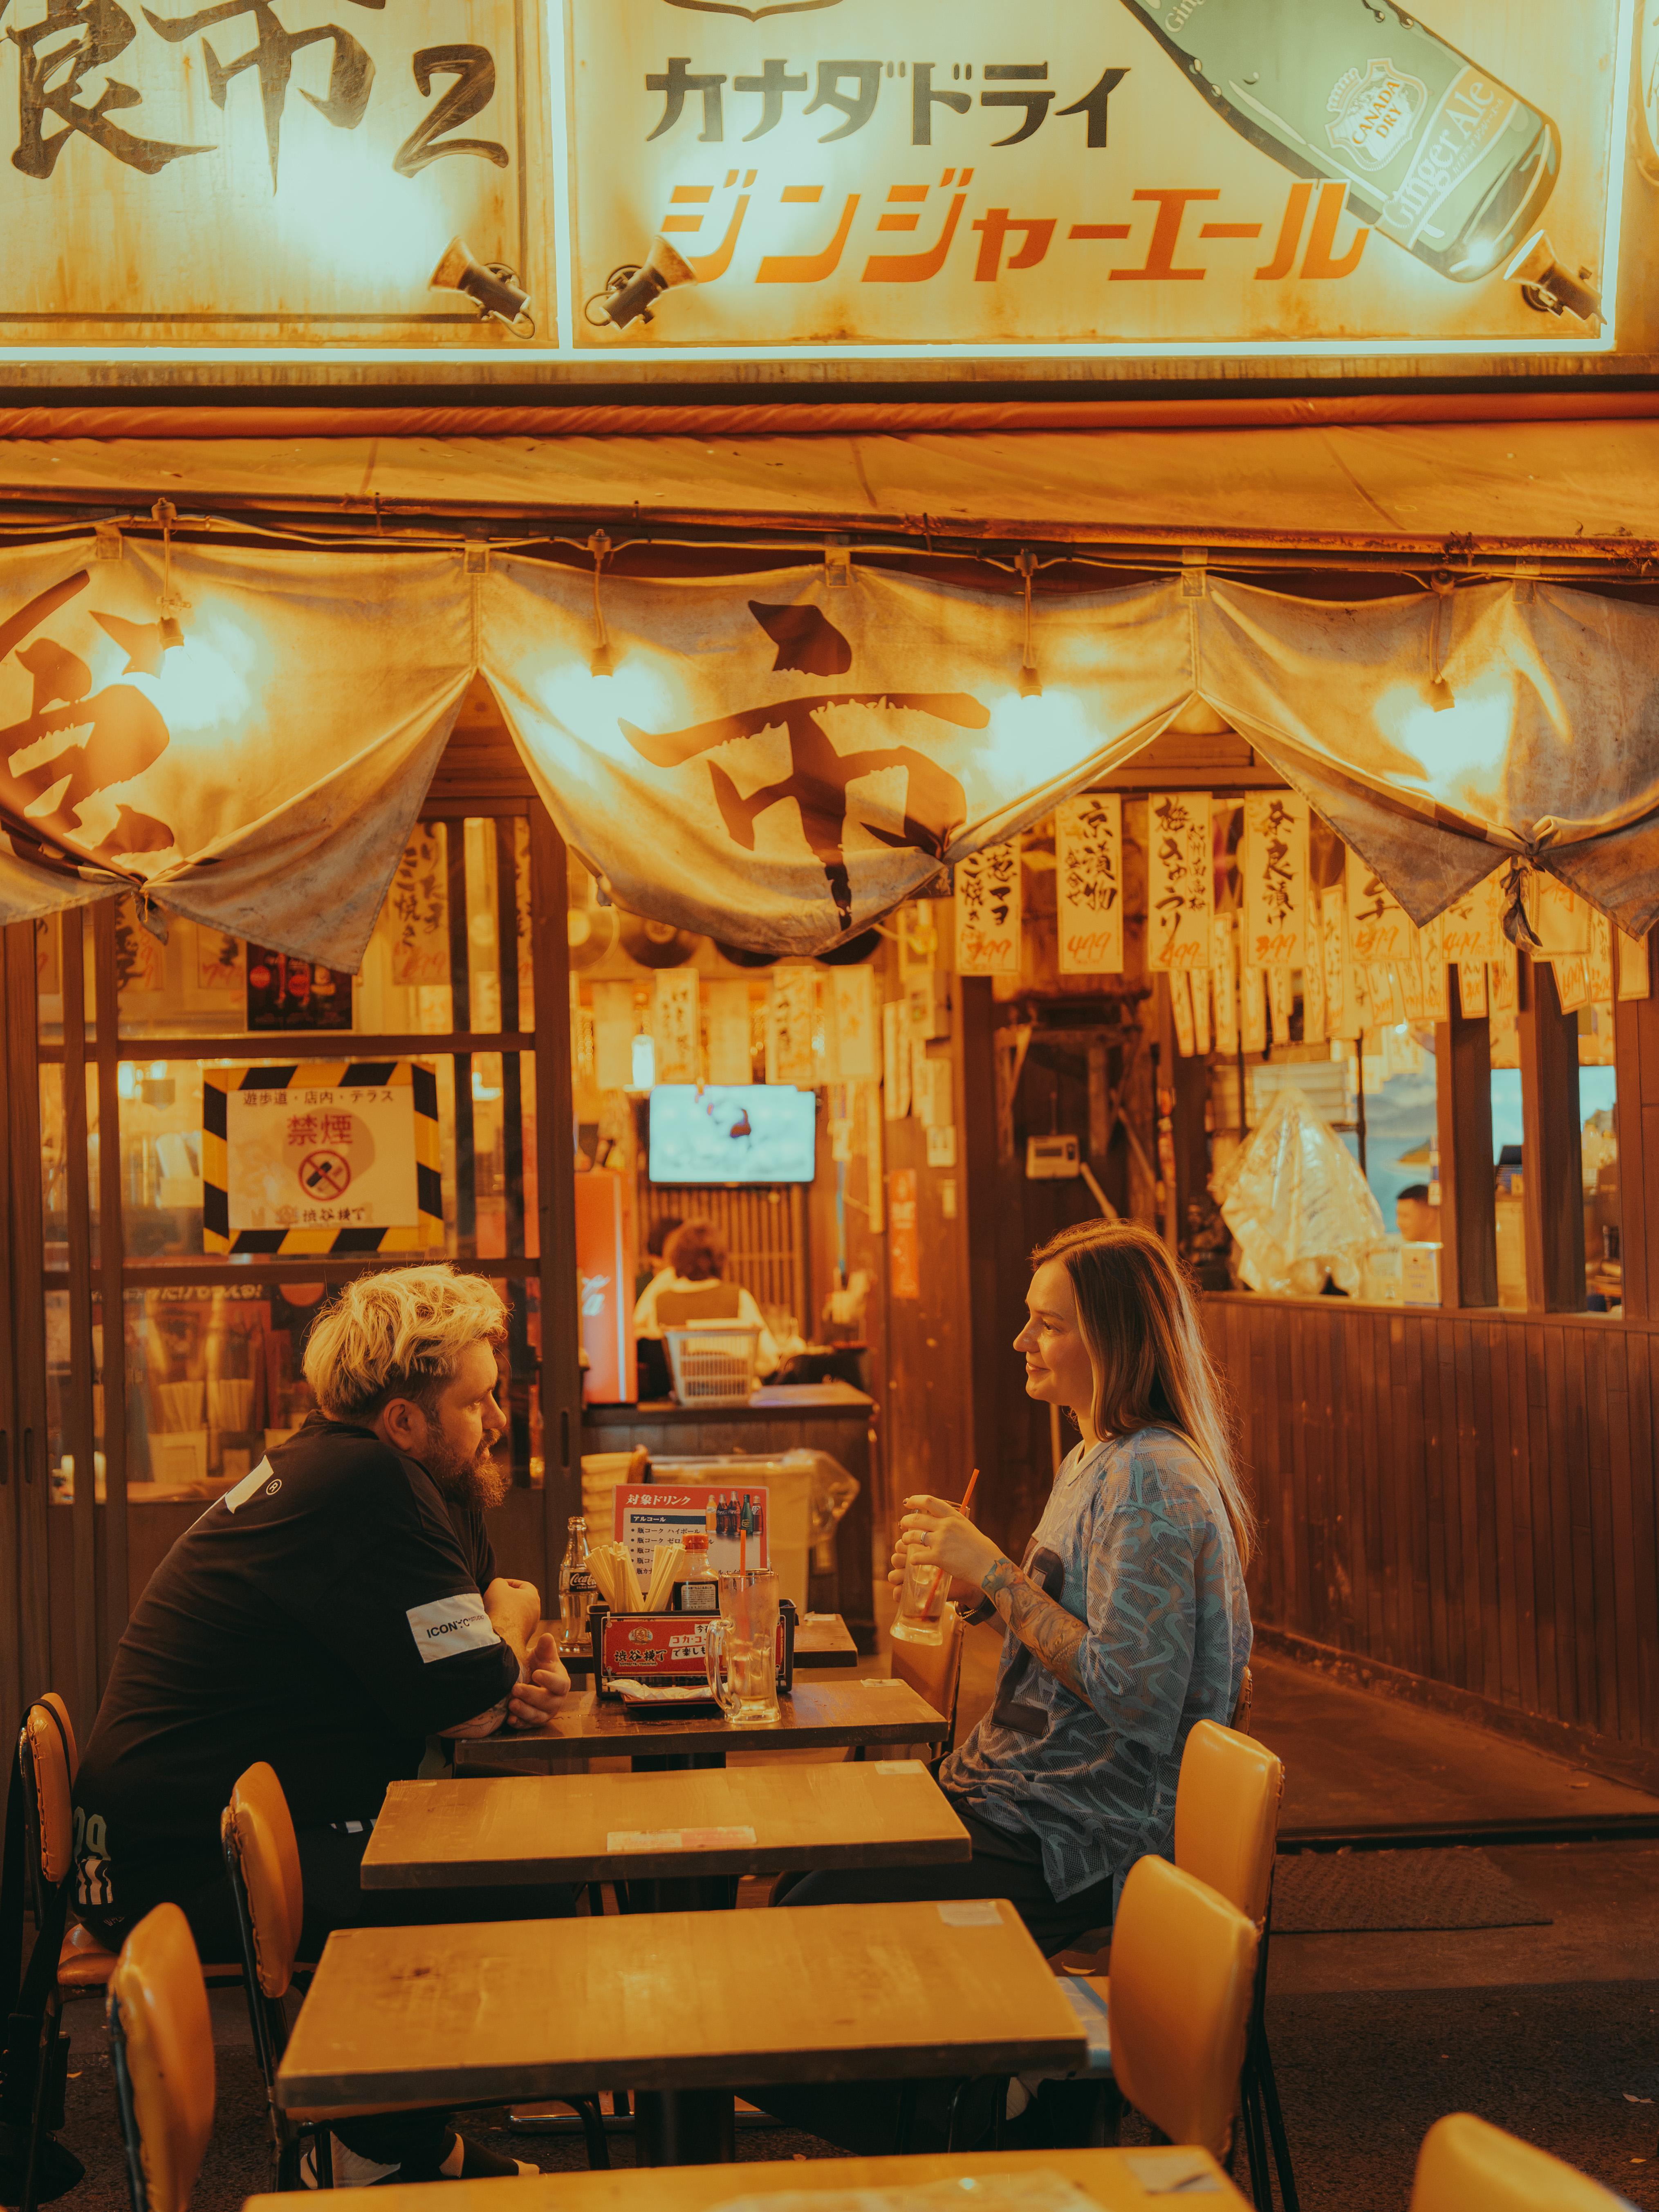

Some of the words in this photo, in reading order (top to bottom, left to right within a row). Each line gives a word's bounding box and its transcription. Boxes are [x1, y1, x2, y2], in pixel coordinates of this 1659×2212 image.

[645, 57, 1132, 148] カナダドライ
[1352, 81, 1400, 145] CANADA
[1375, 104, 1403, 139] DRY
[1383, 128, 1461, 229] Ginger
[1445, 81, 1495, 139] Ale
[659, 167, 1370, 284] ジンジャーエール
[617, 599, 991, 932] 市
[1262, 800, 1296, 933] 奈良漬け
[287, 1114, 353, 1146] 禁煙
[625, 1494, 691, 1506] 対象ドリンク
[614, 1649, 667, 1662] 渋谷横丁
